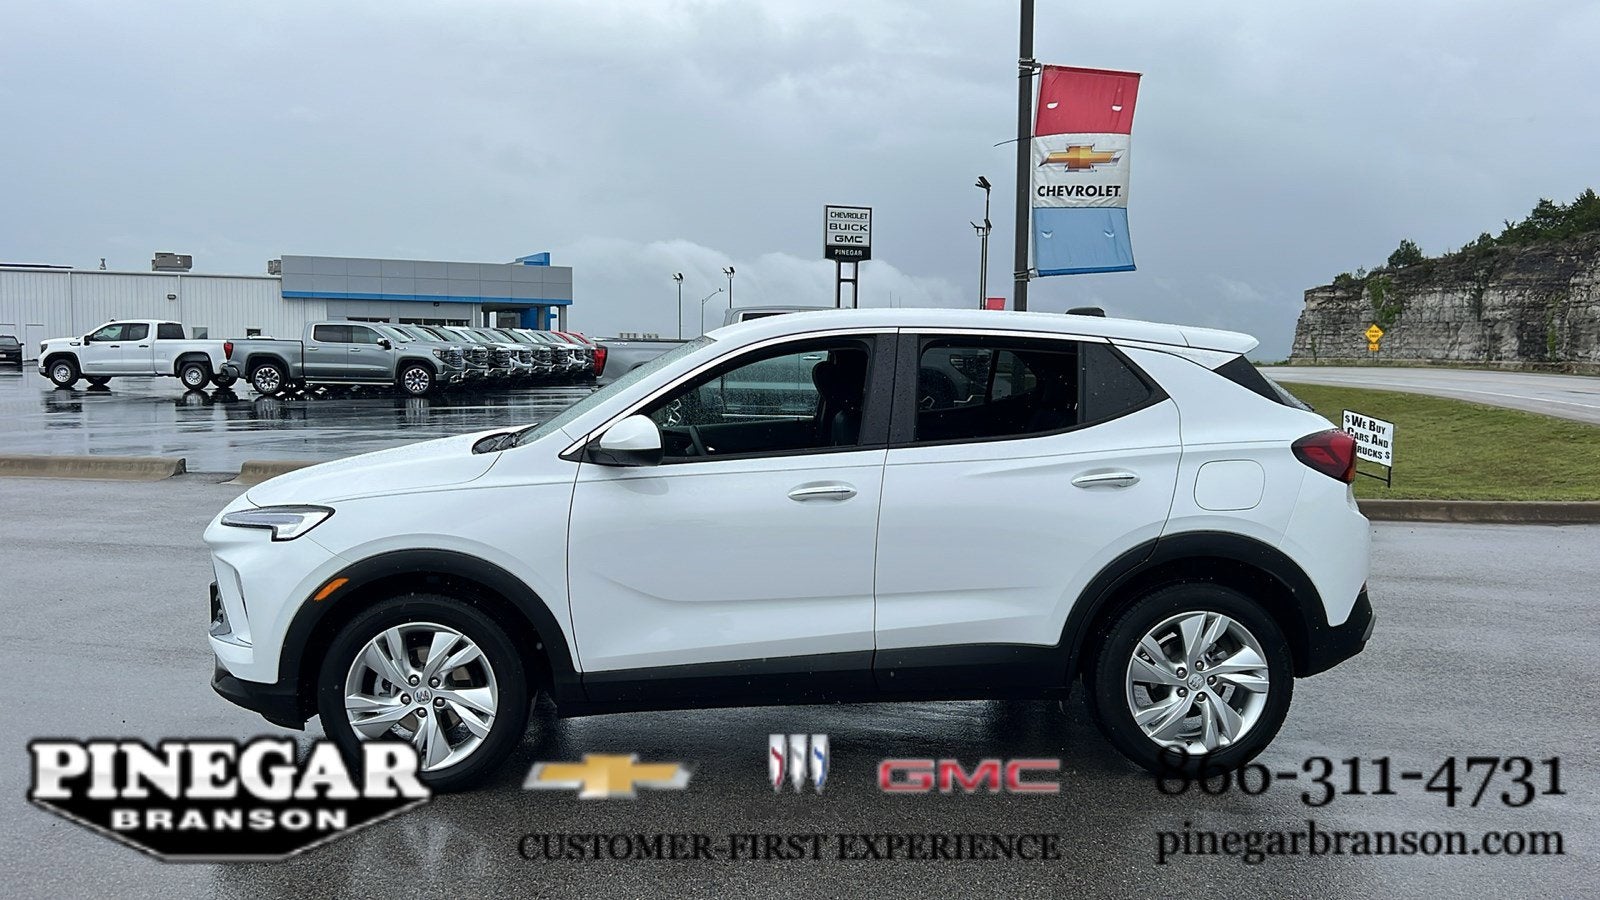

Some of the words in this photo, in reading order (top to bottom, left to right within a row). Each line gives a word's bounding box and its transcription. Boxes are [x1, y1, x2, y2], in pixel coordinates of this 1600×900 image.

[1037, 185, 1121, 197] CHEVROLET
[830, 211, 868, 219] CHEVROLET
[829, 223, 868, 231] BUICK
[834, 235, 863, 243] GMC
[1357, 445, 1382, 459] RUCKS
